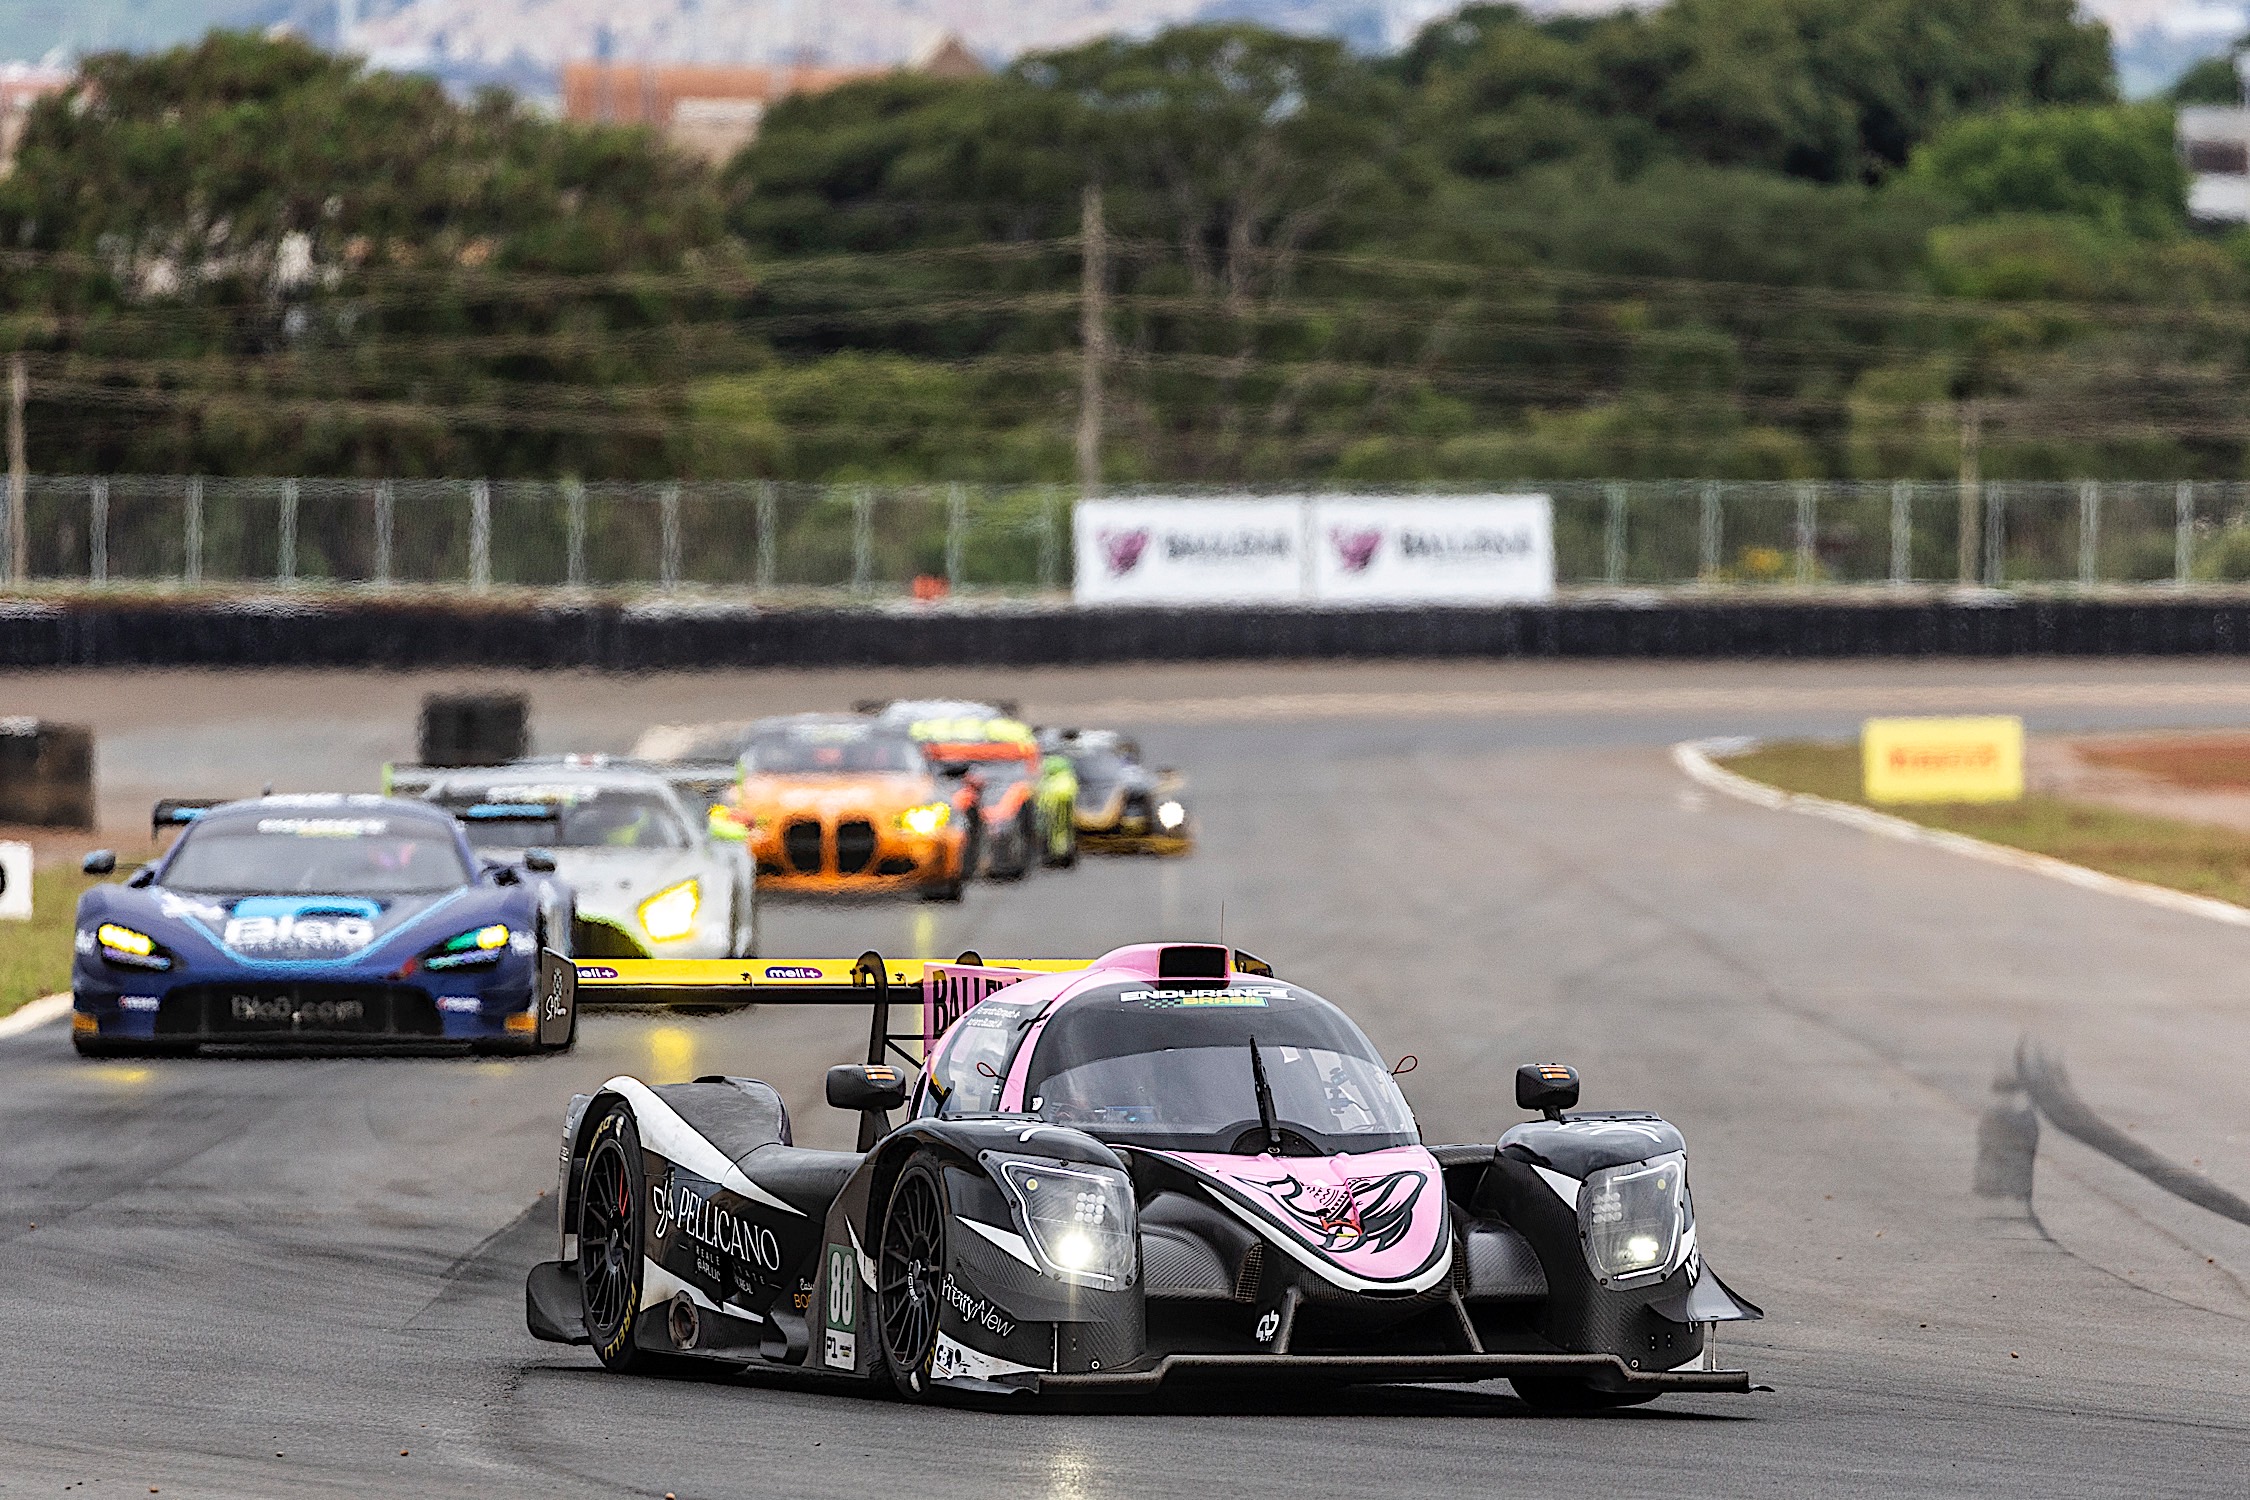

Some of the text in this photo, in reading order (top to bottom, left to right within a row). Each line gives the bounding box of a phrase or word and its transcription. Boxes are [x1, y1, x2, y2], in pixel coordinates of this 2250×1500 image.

[1120, 988, 1296, 1002] ENDURANCE
[1182, 996, 1263, 1005] BRASIL
[677, 1187, 780, 1271] PELLICANO
[604, 1280, 638, 1361] PIRELLI
[830, 1251, 854, 1326] 88
